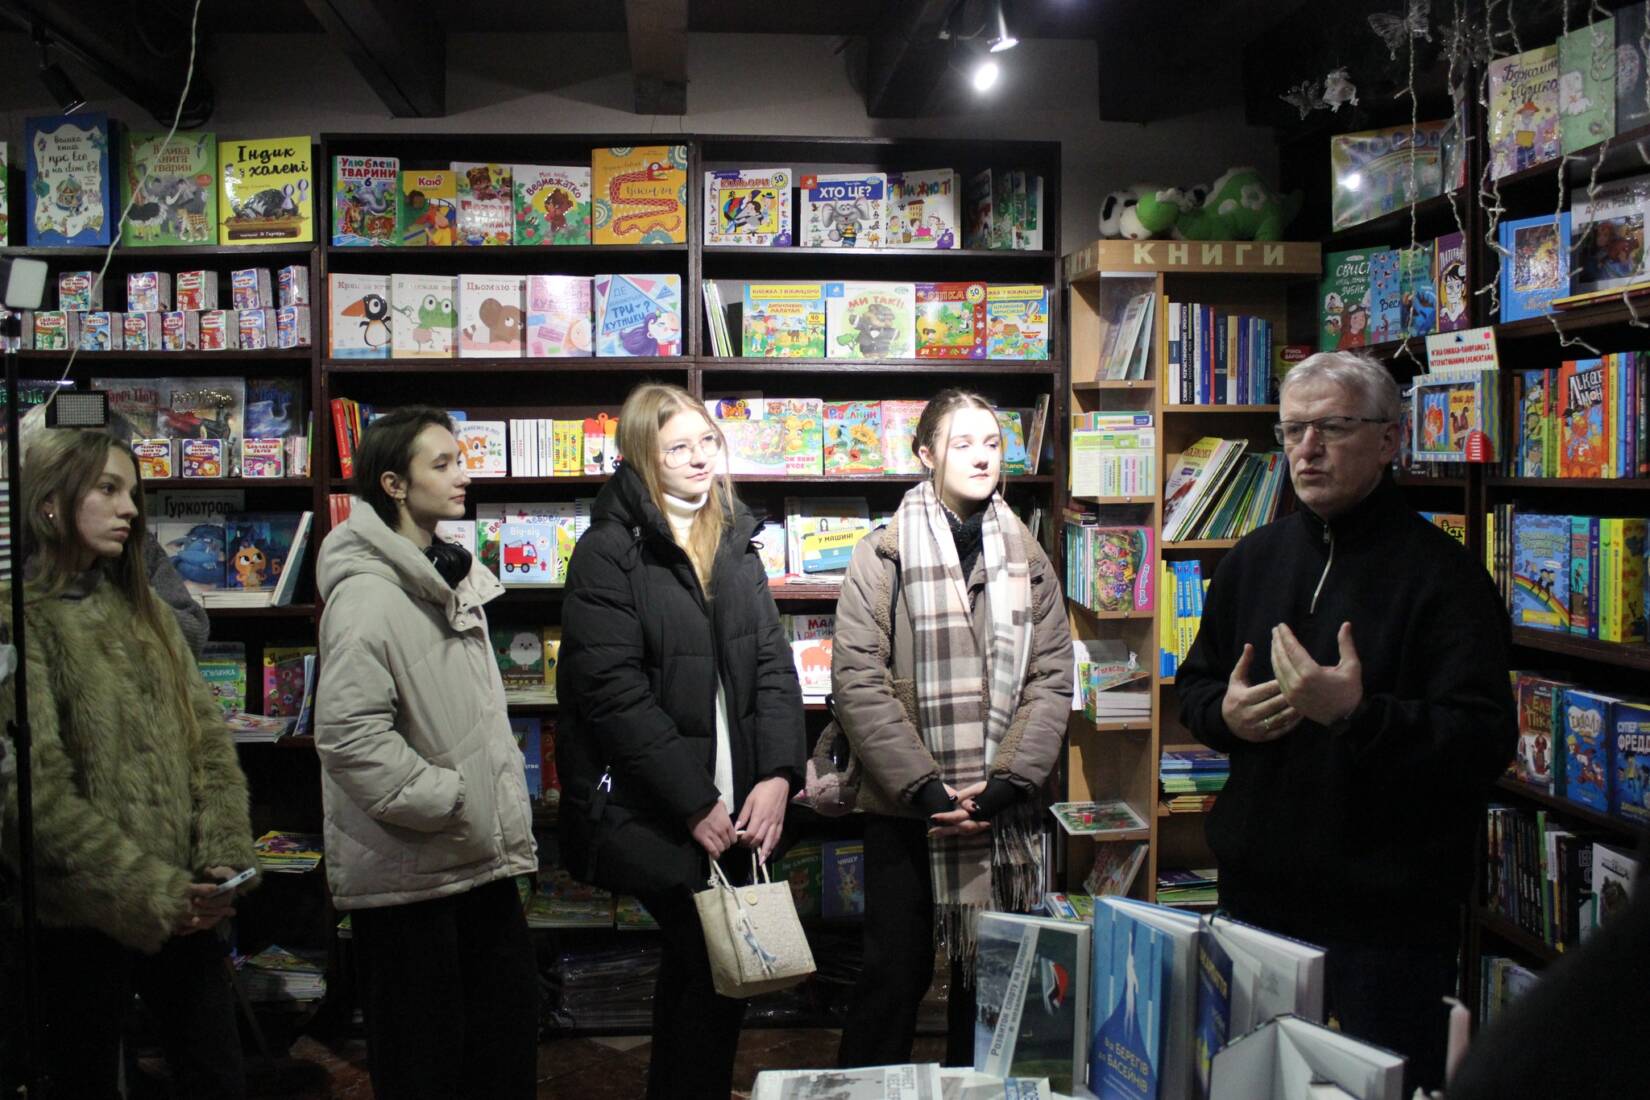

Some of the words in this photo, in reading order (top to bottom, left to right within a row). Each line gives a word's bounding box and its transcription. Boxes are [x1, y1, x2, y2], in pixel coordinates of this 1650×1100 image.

[237, 145, 296, 163] Індик
[249, 160, 309, 177] халепі
[341, 168, 397, 178] ТВАРИНИ
[364, 177, 372, 187] 6
[774, 174, 784, 184] 50
[819, 186, 846, 199] ХТО
[847, 185, 872, 198] ЦЕ?
[1133, 243, 1286, 266] КНИГИ
[848, 296, 869, 308] МИ
[1115, 1043, 1149, 1076] БЕРЕГІВ
[1107, 1054, 1148, 1094] БАСЕЙНІВ
